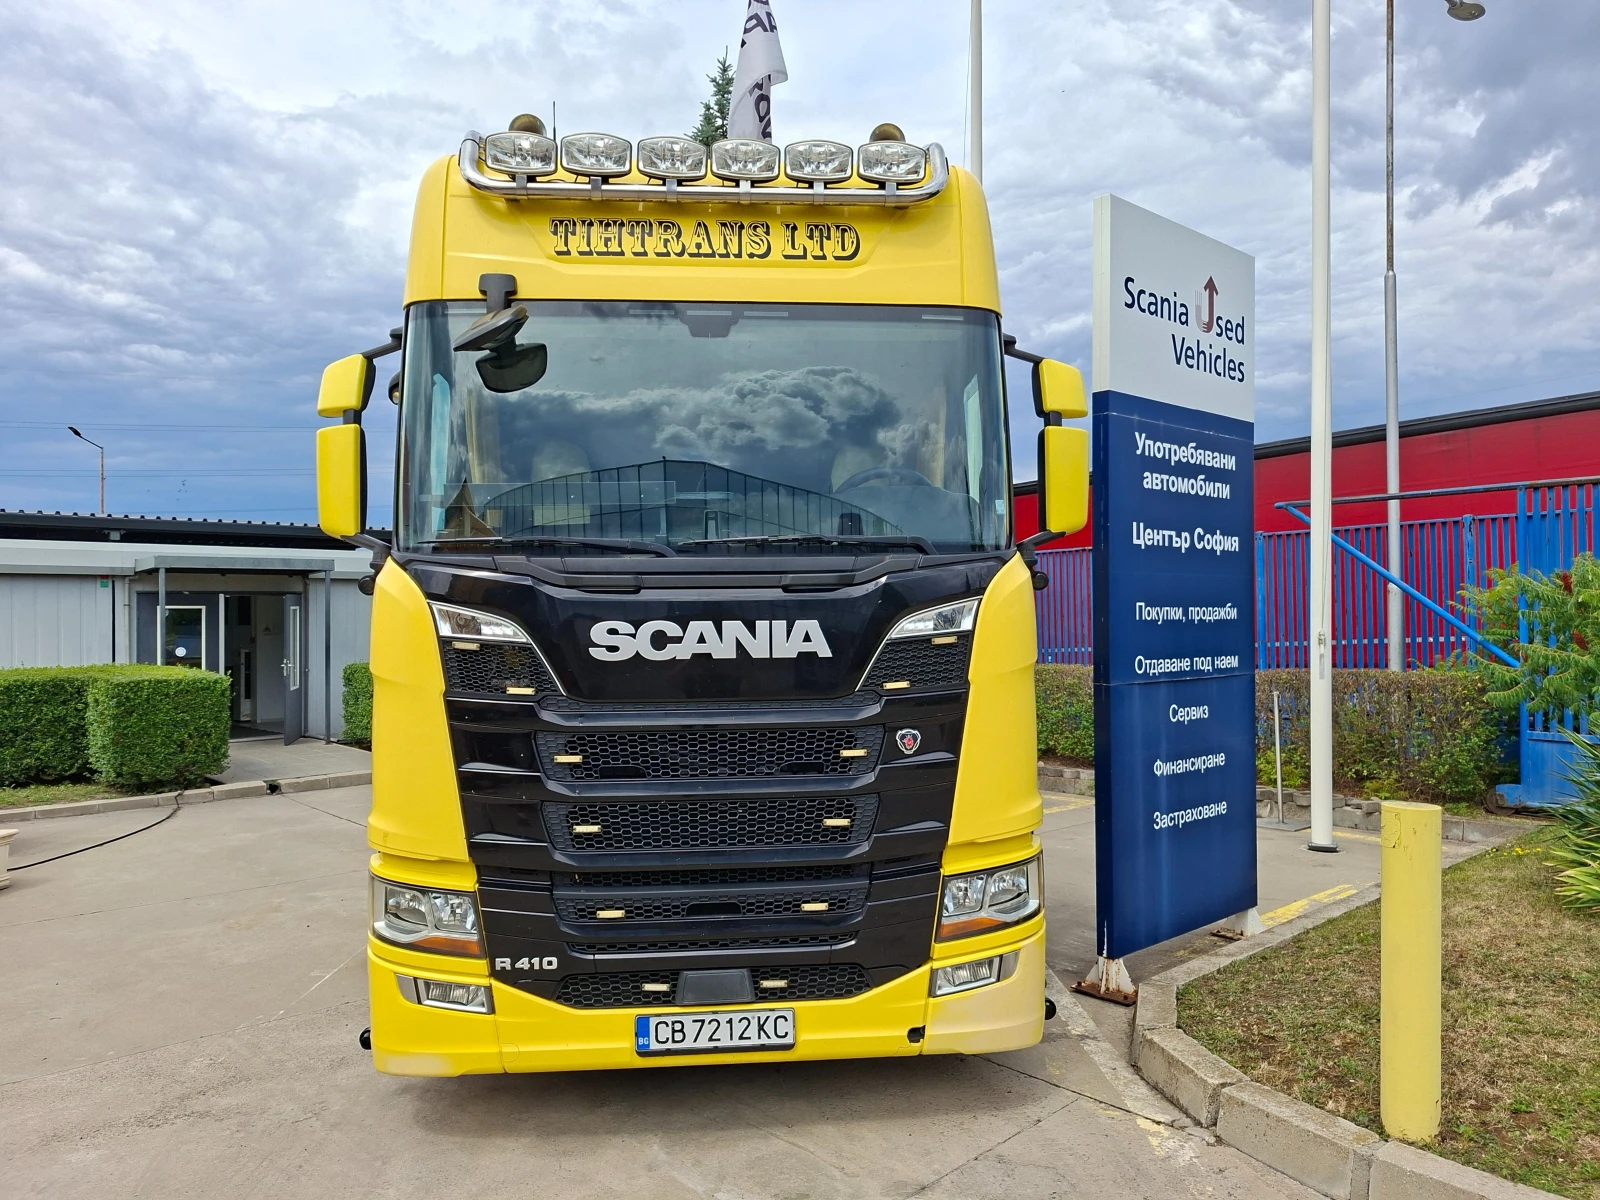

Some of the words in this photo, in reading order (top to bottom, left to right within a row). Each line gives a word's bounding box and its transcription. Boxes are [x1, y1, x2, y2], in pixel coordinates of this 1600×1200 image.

[549, 217, 771, 259] TIHTRANS
[781, 221, 861, 261] LTD
[1123, 276, 1189, 327] Scania
[1194, 275, 1245, 346] Used
[1171, 333, 1245, 383] Vehicles
[1134, 431, 1236, 471] Употребявани
[1143, 471, 1230, 500] автомобили
[1132, 521, 1191, 554] Център
[1194, 527, 1239, 556] София
[1135, 602, 1186, 625] Покупки,
[1188, 602, 1238, 624] продажби
[588, 619, 833, 662] SCANIA
[1134, 655, 1190, 676] Отдаване
[1193, 657, 1212, 674] под
[1214, 654, 1239, 670] наем
[1169, 704, 1209, 725] Сервиз
[1153, 752, 1226, 777] Финансиране
[1153, 800, 1227, 830] Застраховане
[495, 957, 512, 971] R
[514, 956, 558, 971] 410
[638, 1037, 649, 1045] BG
